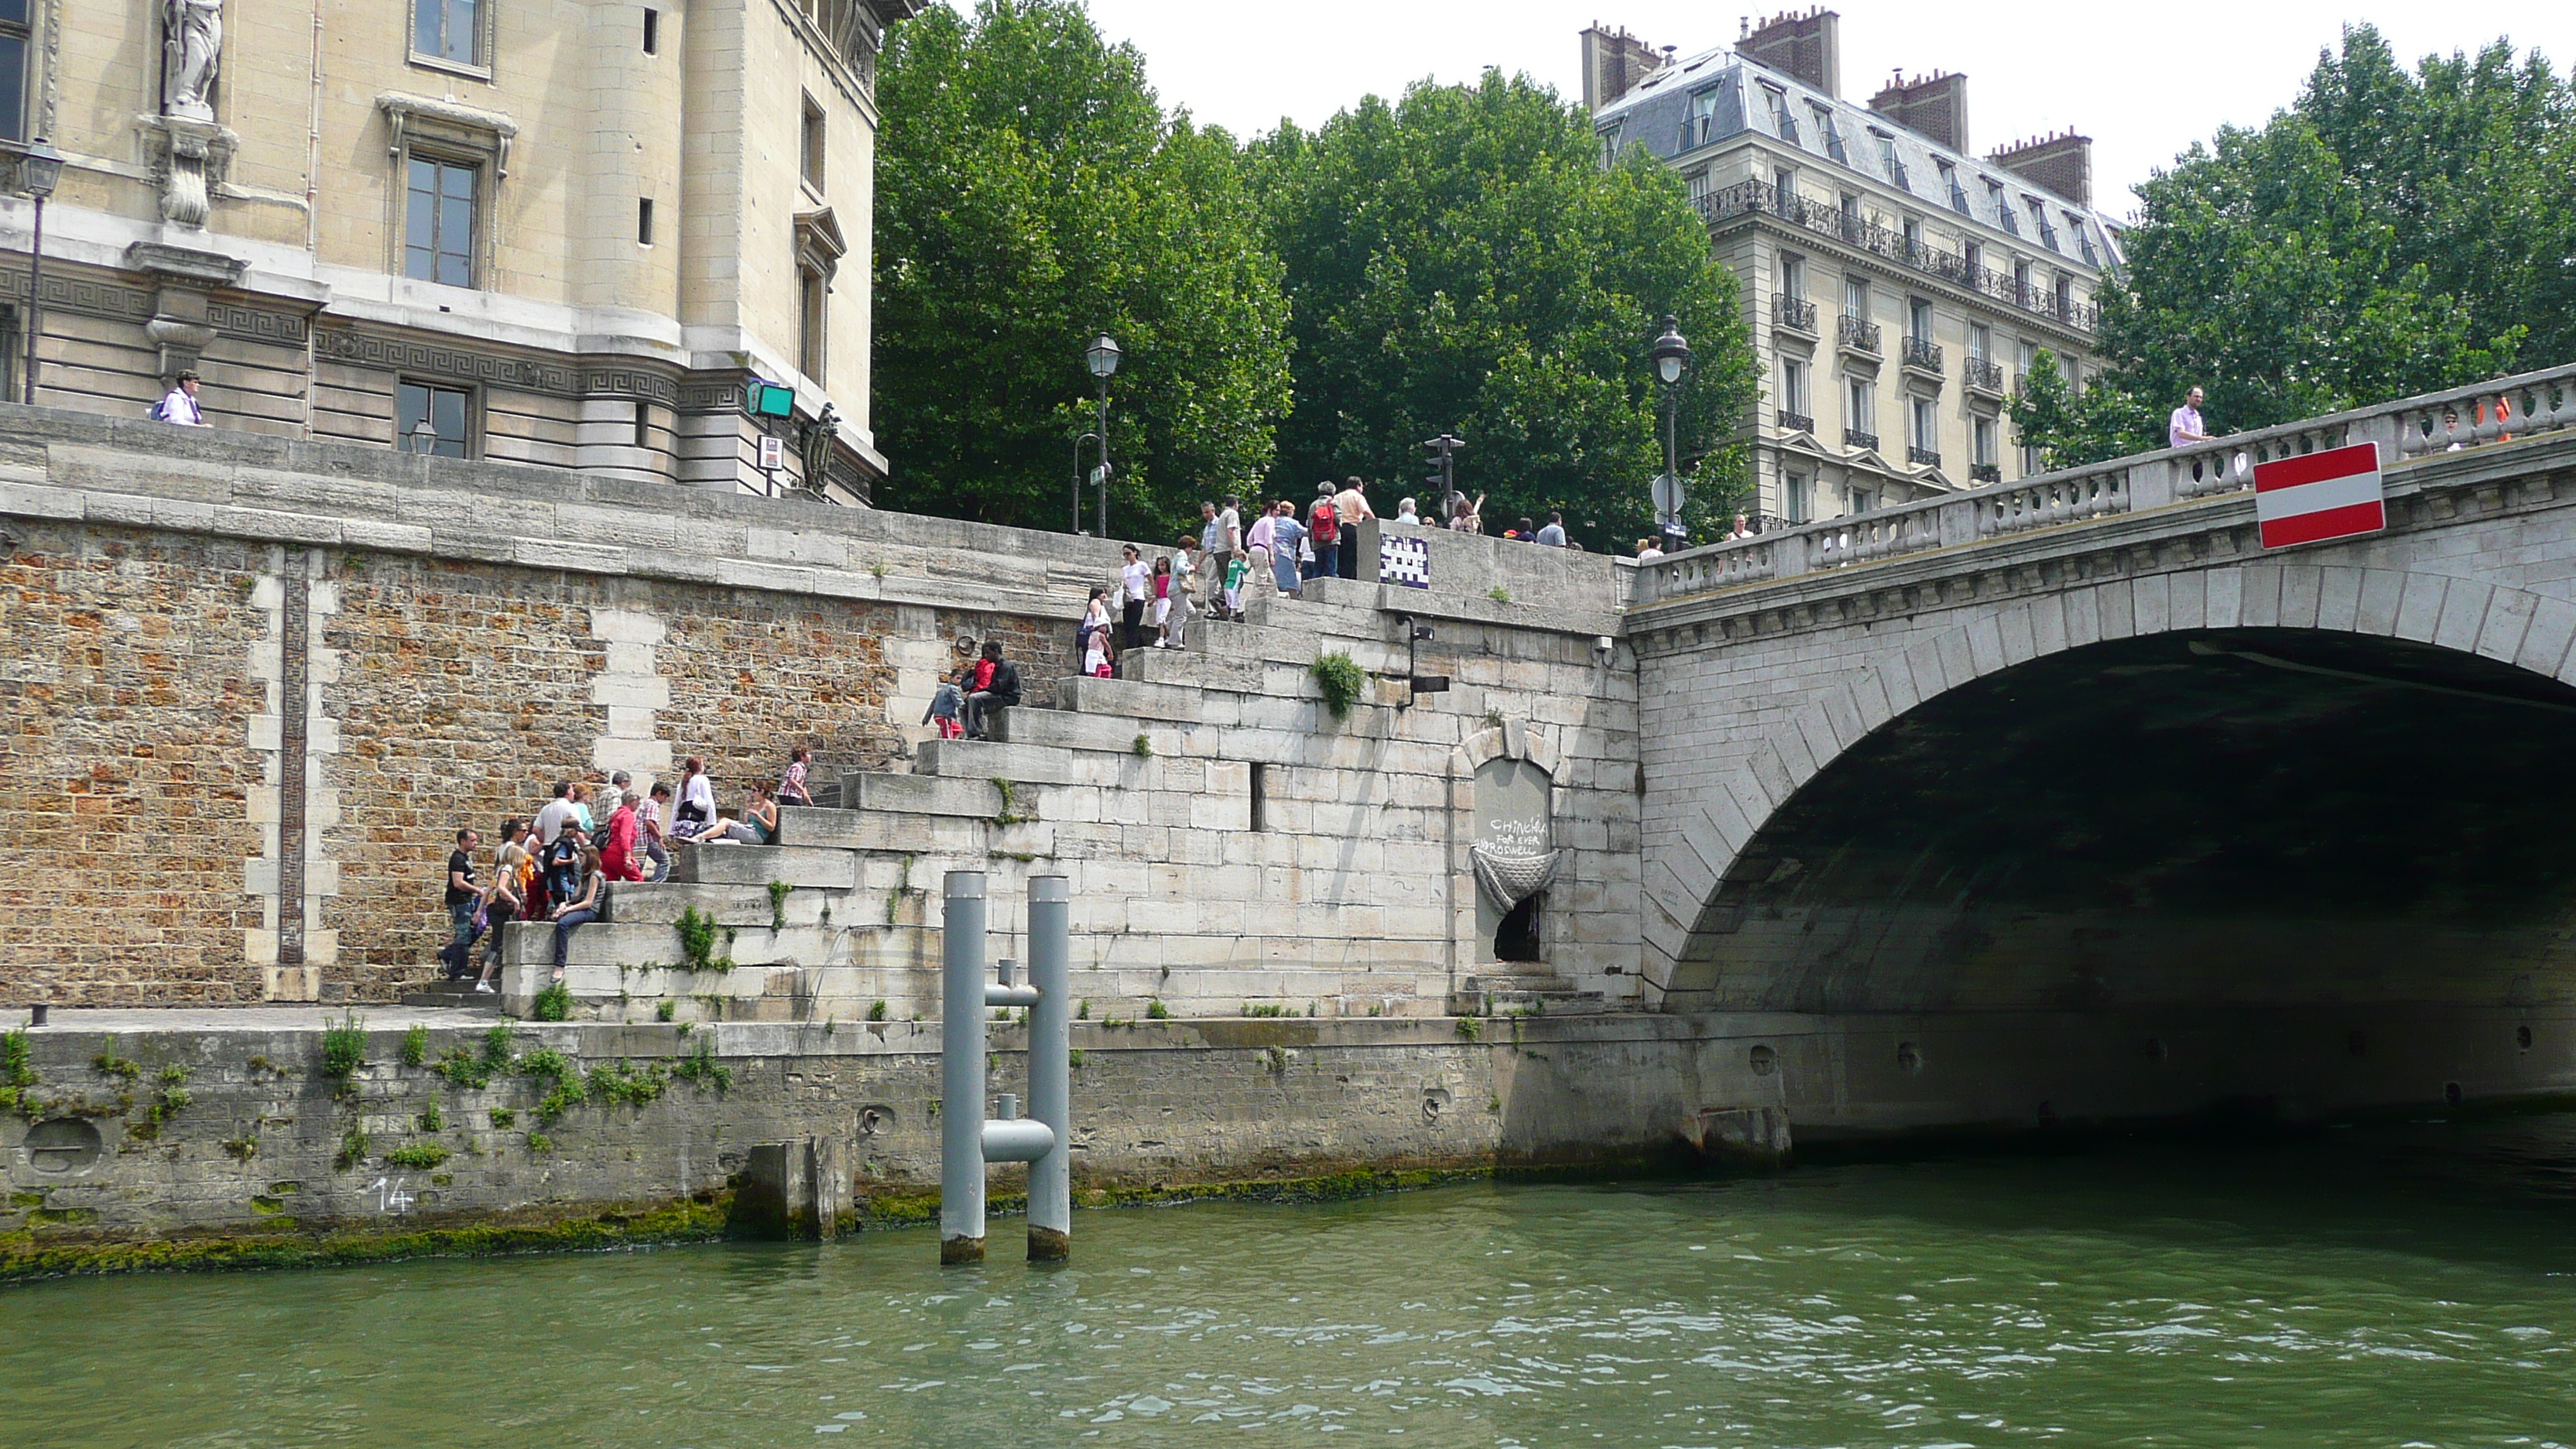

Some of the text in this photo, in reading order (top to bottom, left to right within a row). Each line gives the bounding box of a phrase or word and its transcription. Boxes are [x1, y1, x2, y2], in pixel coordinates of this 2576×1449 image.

[1496, 834, 1540, 845] FOR EVER
[1489, 842, 1536, 855] ROSWELL
[372, 1177, 414, 1211] 14
